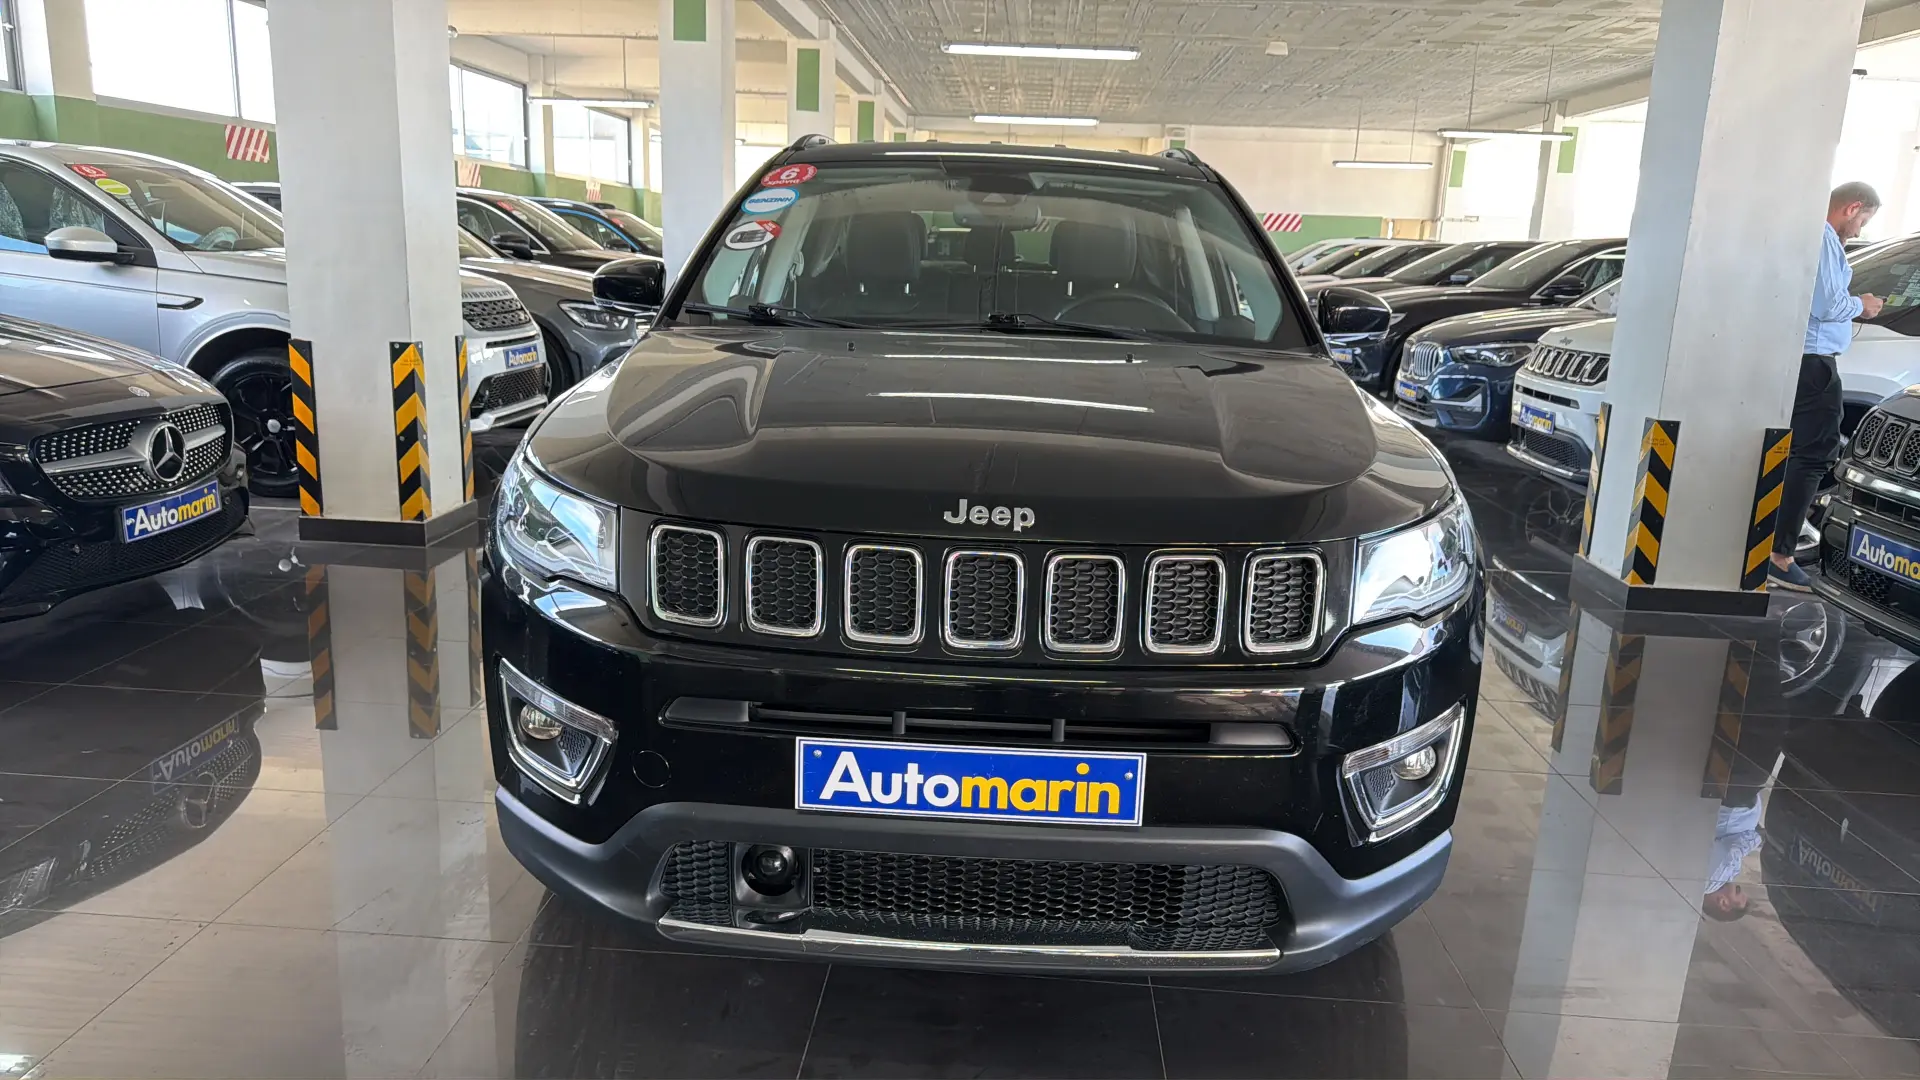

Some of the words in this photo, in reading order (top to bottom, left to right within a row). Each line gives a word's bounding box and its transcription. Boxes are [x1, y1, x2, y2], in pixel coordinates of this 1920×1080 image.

[780, 167, 800, 180] 6
[134, 488, 216, 535] Automarin
[944, 499, 1035, 532] Jeep
[819, 751, 1120, 814] Automarin
